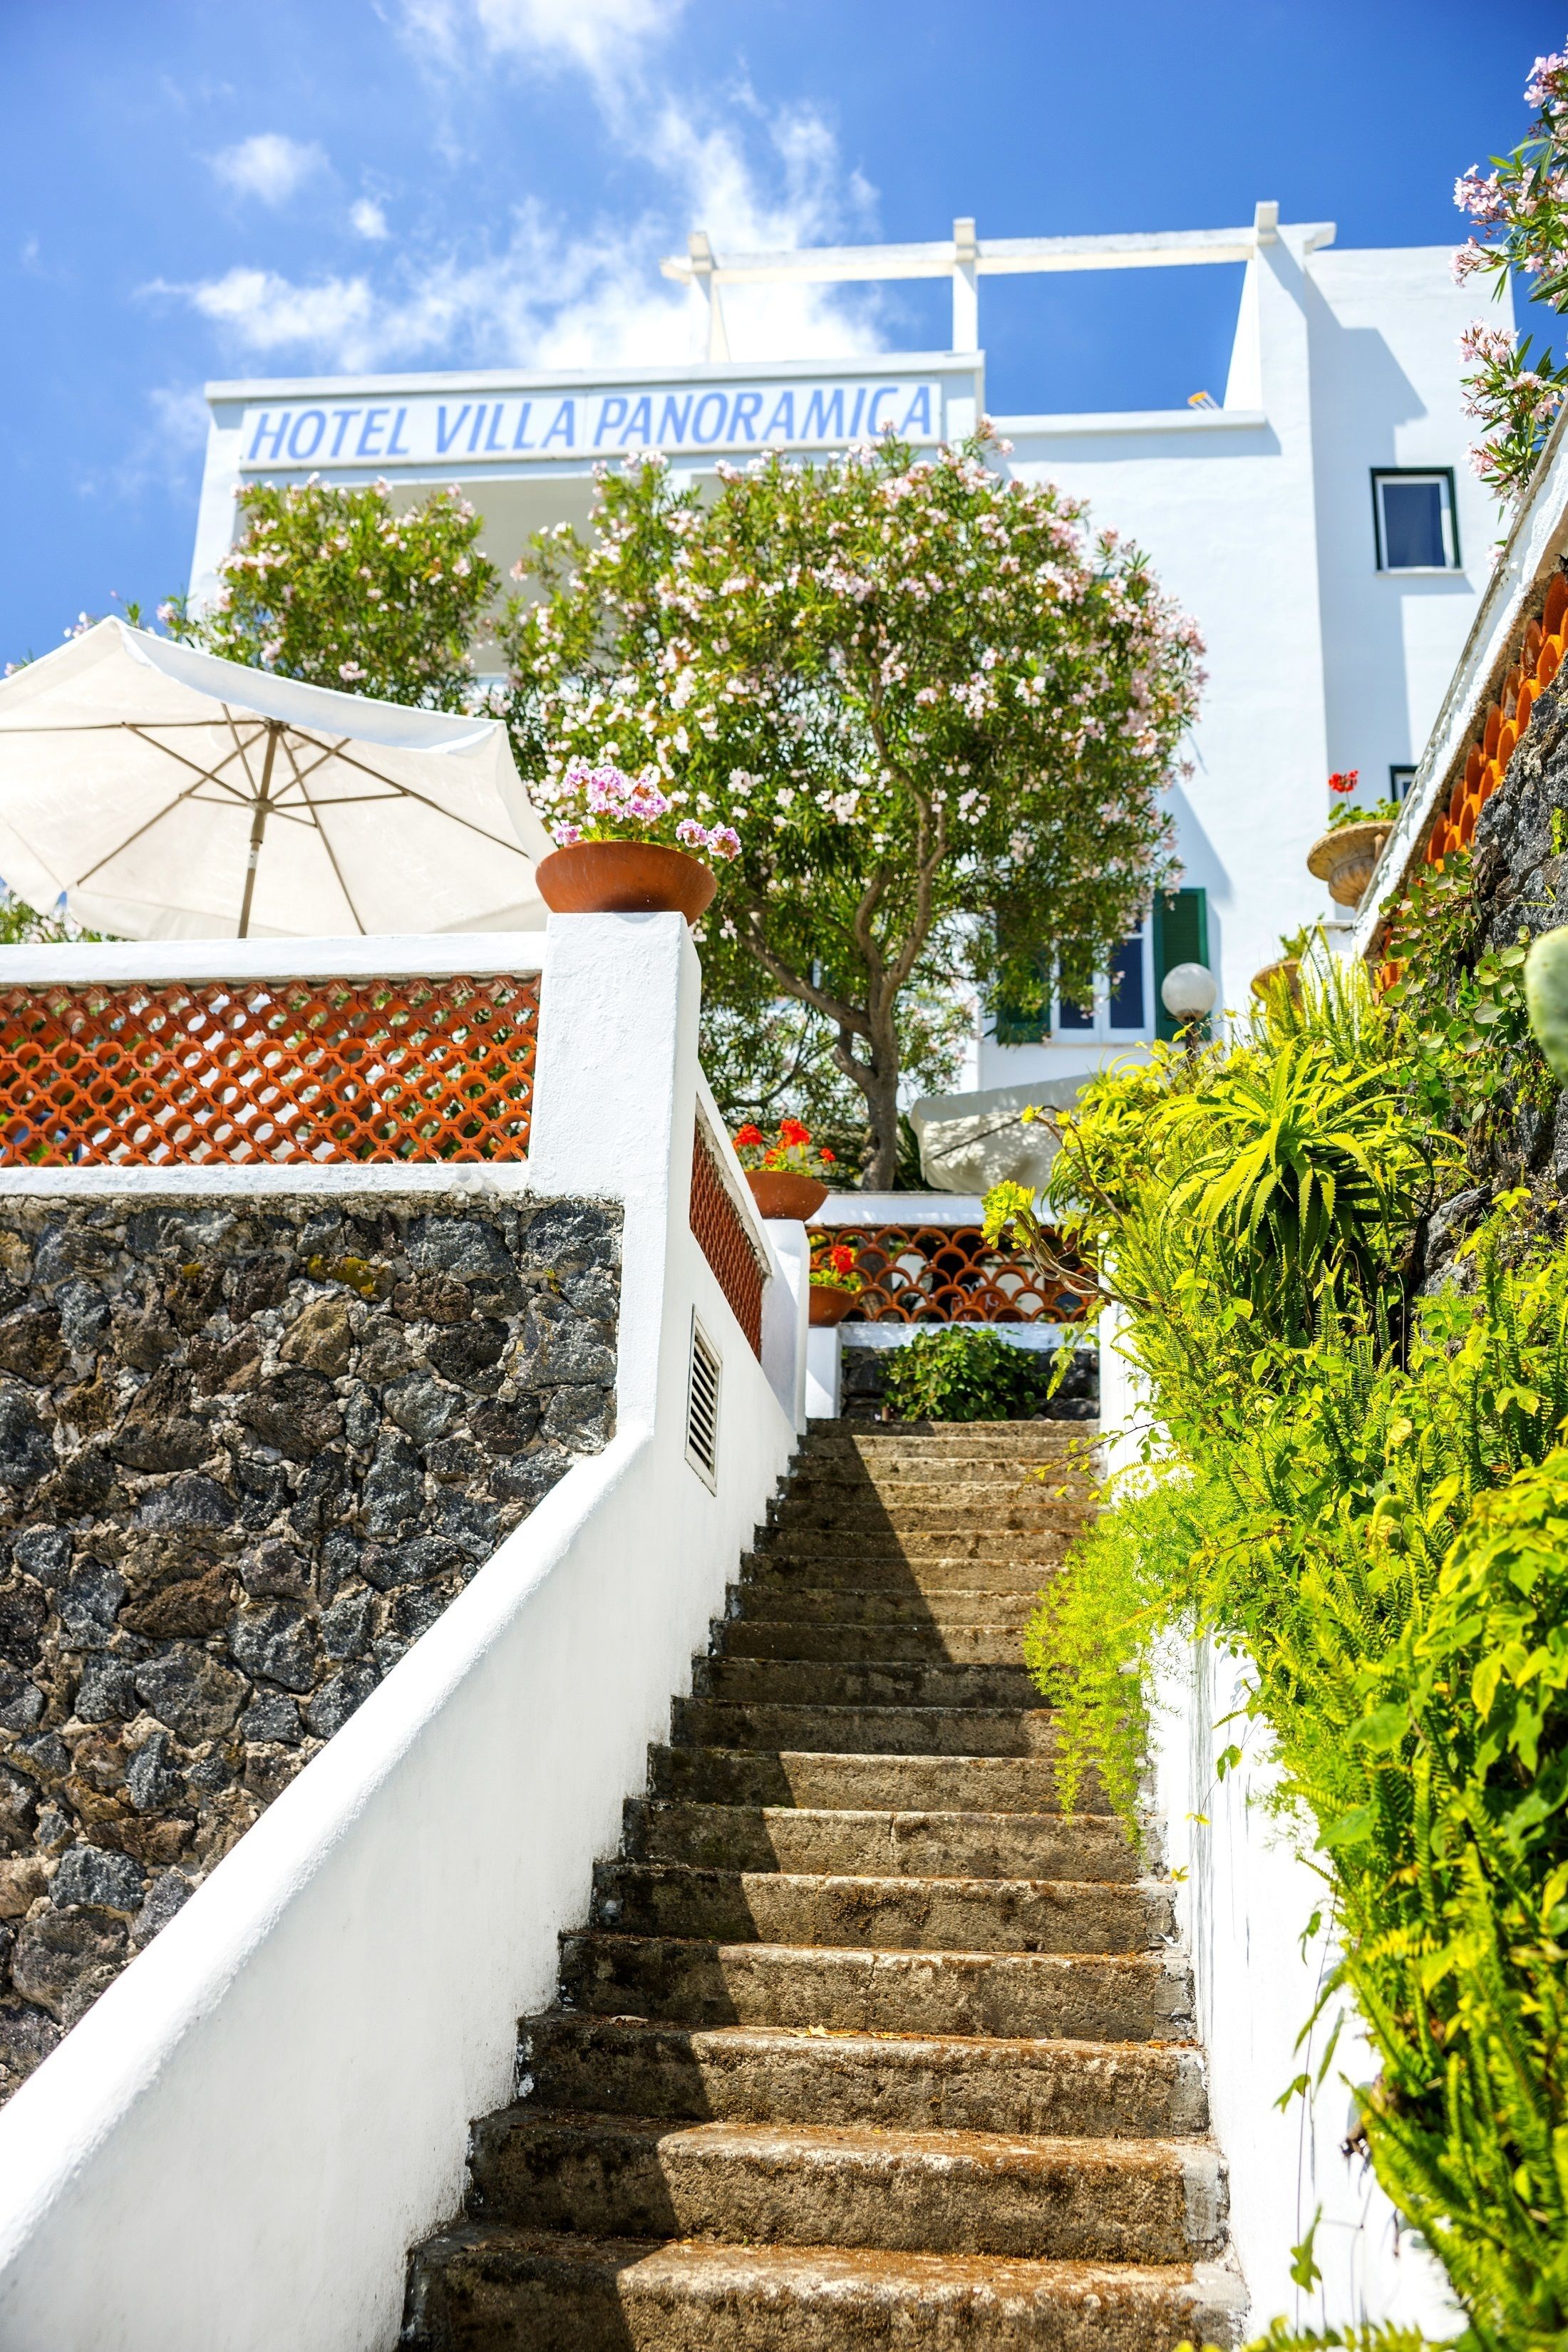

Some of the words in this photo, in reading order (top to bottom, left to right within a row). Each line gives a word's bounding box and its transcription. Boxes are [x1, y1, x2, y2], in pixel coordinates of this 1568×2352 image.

[247, 406, 409, 461] HOTEL
[435, 398, 575, 454] VILLA
[592, 385, 932, 447] PANORAMICA
